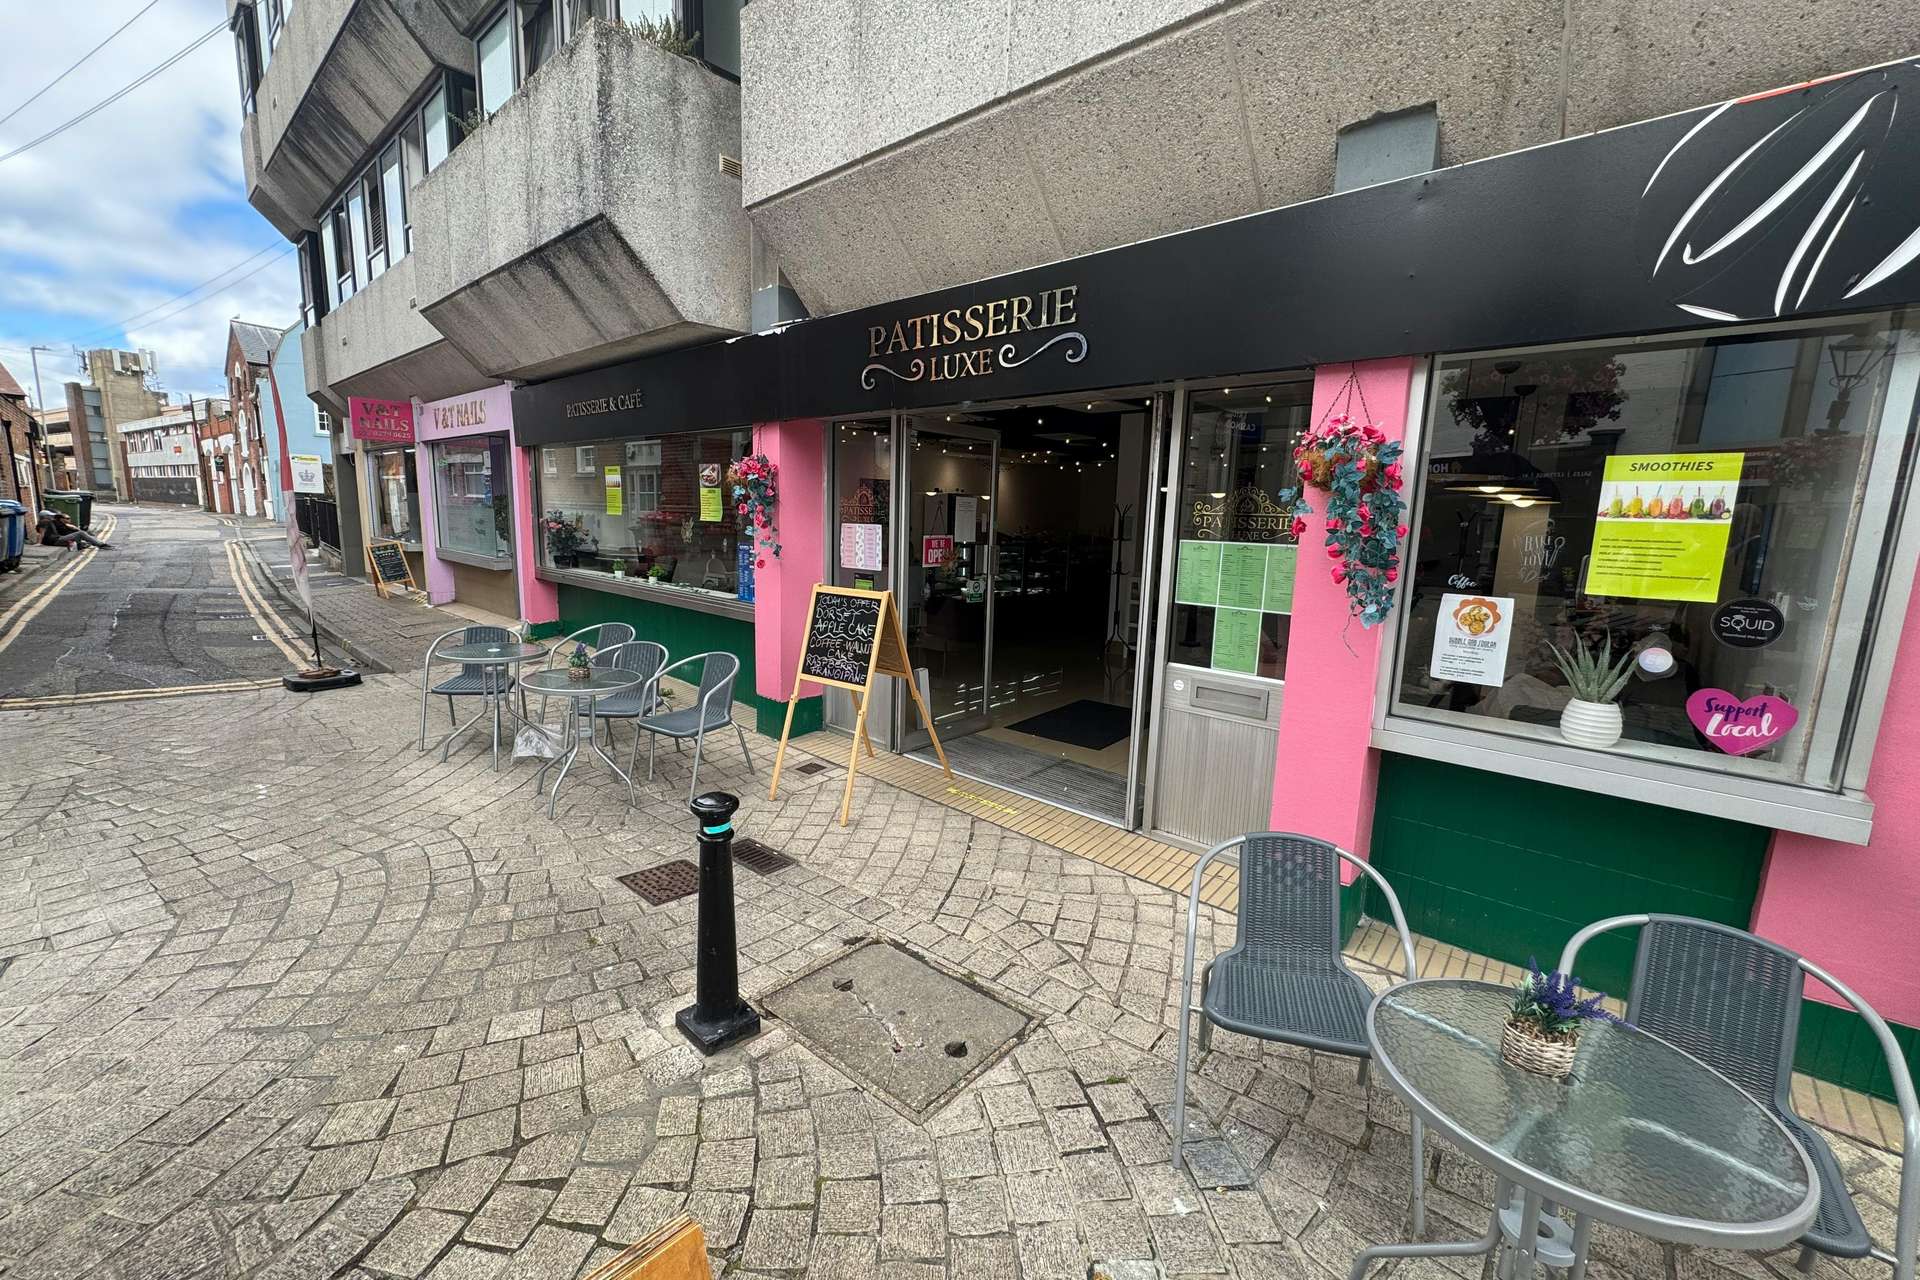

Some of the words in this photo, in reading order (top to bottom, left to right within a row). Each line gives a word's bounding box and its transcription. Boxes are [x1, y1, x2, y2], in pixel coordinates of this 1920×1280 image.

[868, 285, 1078, 358] PATISSERIE
[929, 348, 994, 382] LUXE
[566, 398, 608, 418] PATISSERIE
[609, 396, 617, 411] &
[617, 388, 643, 410] CAFÉ
[456, 399, 487, 428] NAILS
[359, 416, 410, 432] NAILS
[1629, 461, 1714, 472] SMOOTHIES
[1447, 574, 1479, 589] Coffee
[850, 598, 880, 610] OFFER
[816, 608, 860, 624] DORSET
[1719, 614, 1775, 632] SQUID
[814, 619, 845, 633] APPLE
[848, 623, 876, 637] CAKE
[806, 656, 859, 675] RASPBERRY
[811, 667, 866, 684] FRANGIPANE
[1704, 697, 1769, 722] Support
[1705, 712, 1779, 738] Local
